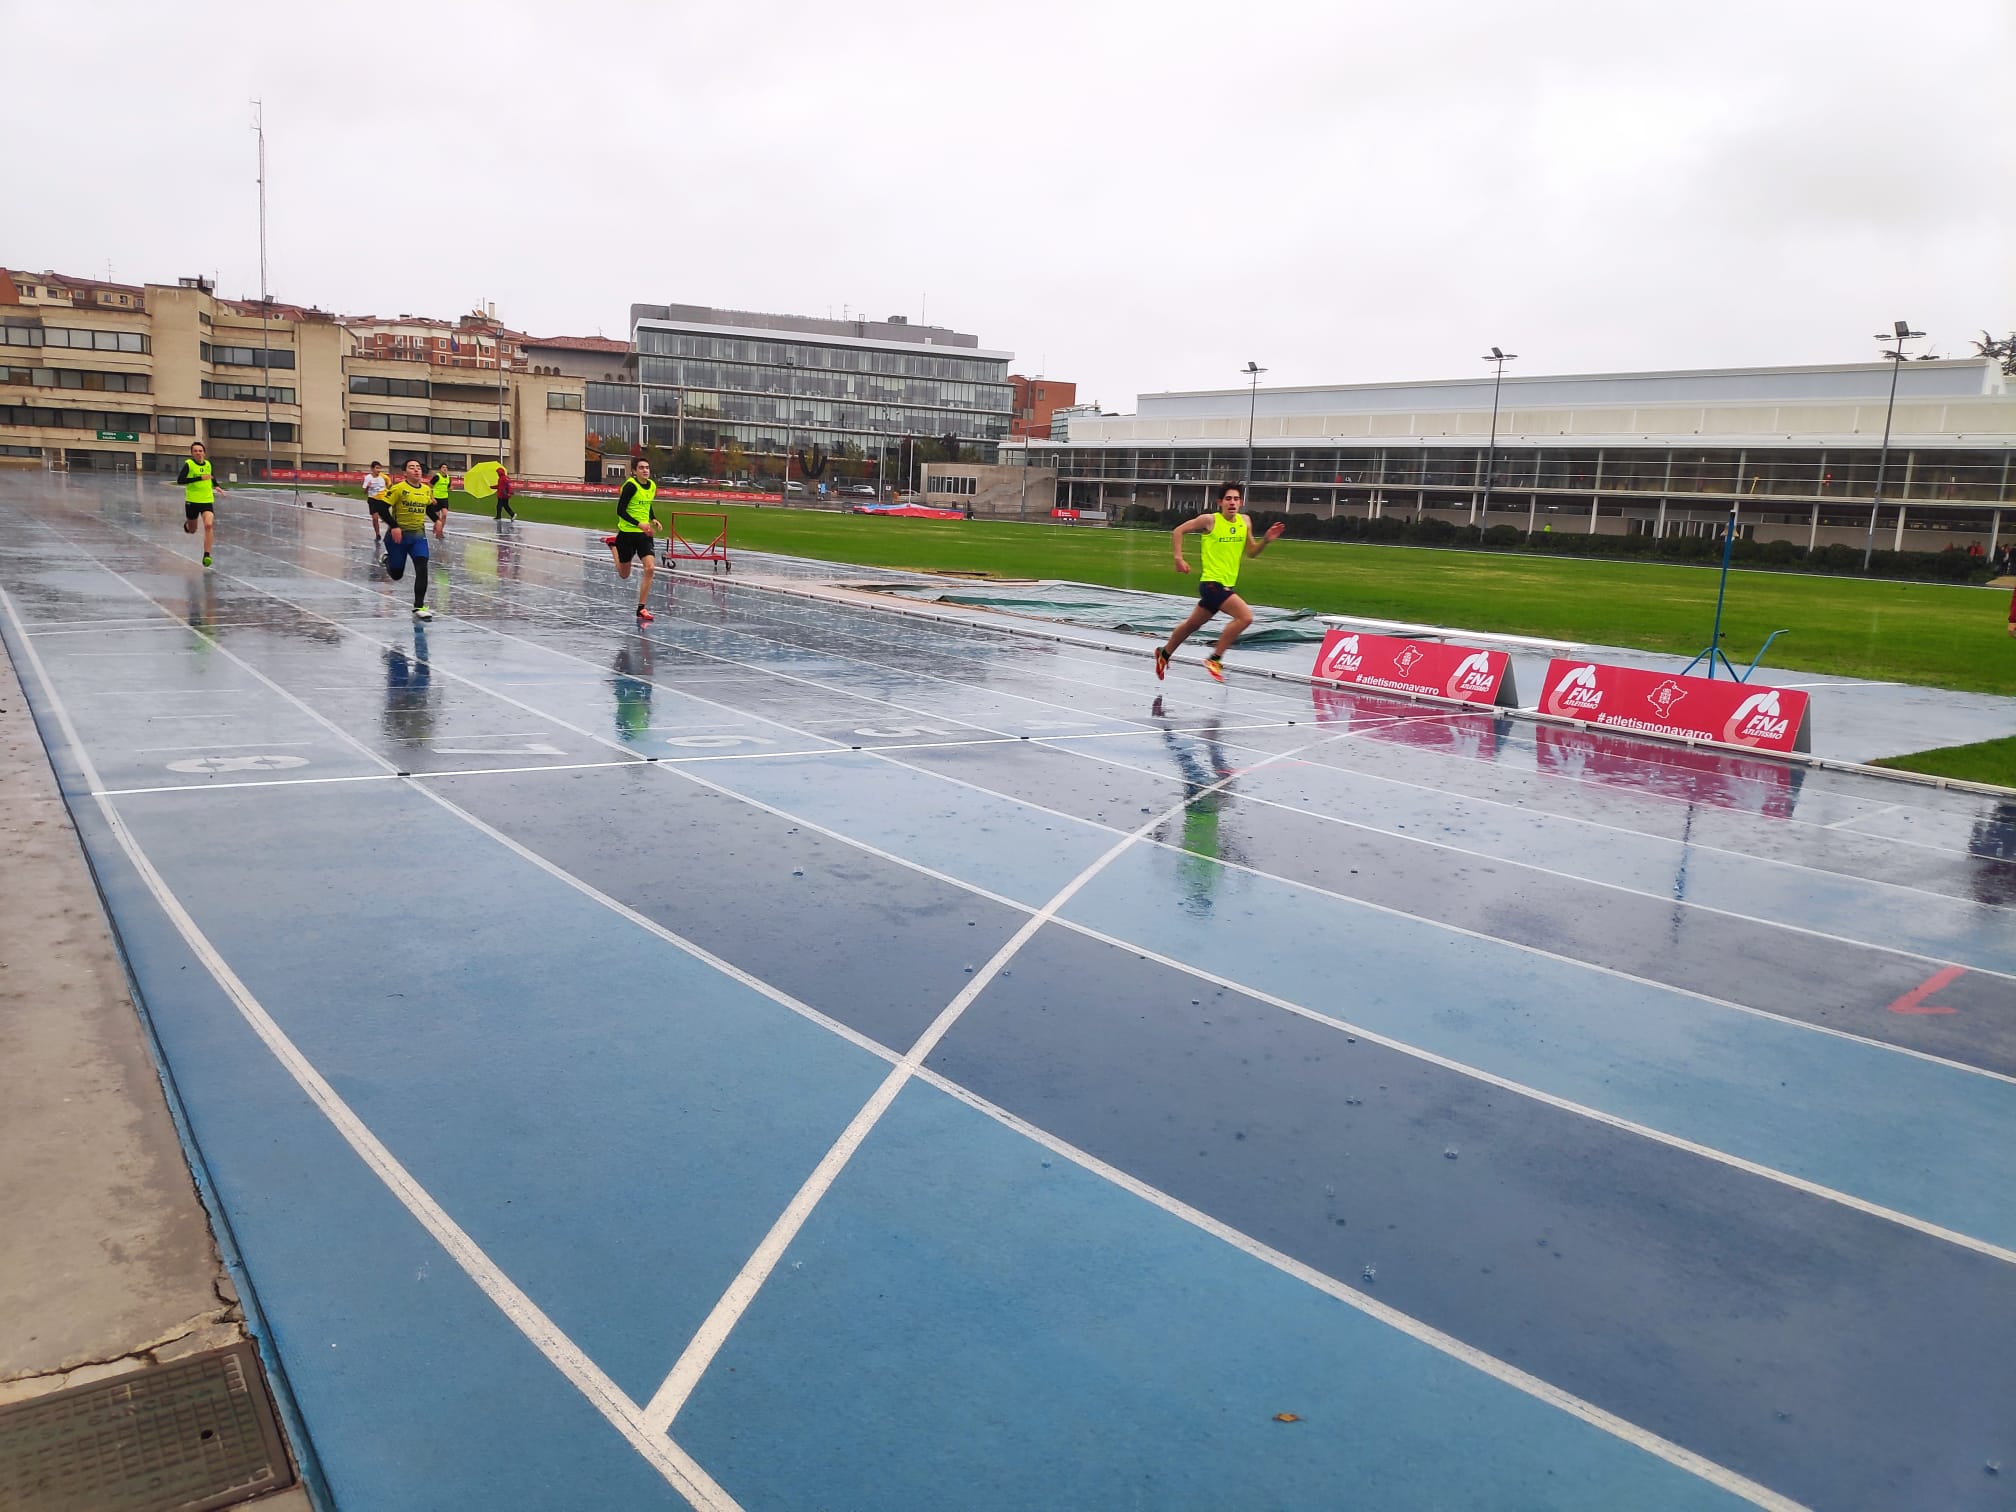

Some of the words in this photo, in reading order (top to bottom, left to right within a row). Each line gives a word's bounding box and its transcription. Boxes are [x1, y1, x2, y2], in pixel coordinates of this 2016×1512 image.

[1338, 653, 1363, 668] FNA
[1356, 674, 1439, 695] #atletismonavarro
[1463, 672, 1495, 687] FNA
[1568, 687, 1604, 704] FNA
[1563, 699, 1599, 710] ATLETISMO
[853, 724, 960, 739] 5
[1597, 713, 1713, 741] #atletismonavarro
[1746, 715, 1789, 735] FNA
[666, 734, 778, 748] 6
[1741, 728, 1783, 740] ATLETISMO
[432, 743, 568, 755] 7
[166, 755, 310, 773] 8
